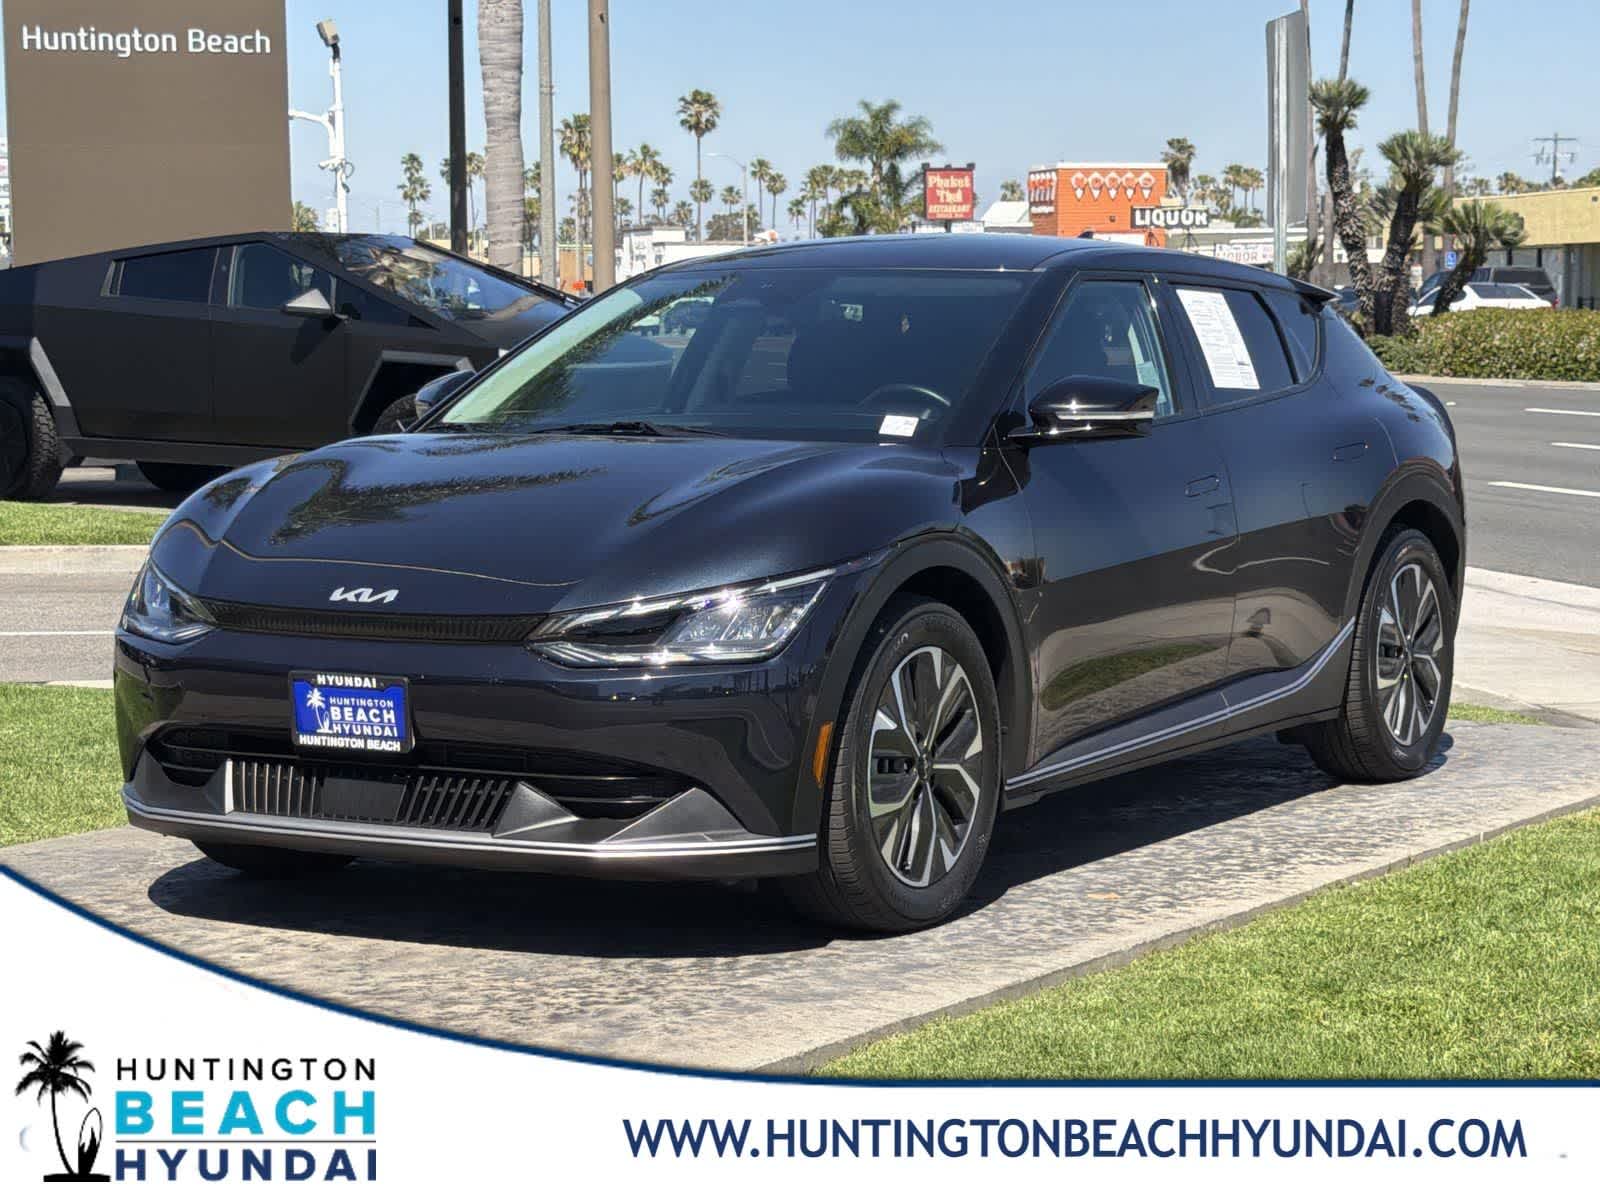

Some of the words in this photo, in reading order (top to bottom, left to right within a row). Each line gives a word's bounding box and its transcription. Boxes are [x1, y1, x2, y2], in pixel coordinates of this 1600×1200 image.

[21, 25, 177, 57] Huntington
[187, 29, 271, 54] Beach
[1135, 208, 1208, 227] LIQUOR
[316, 674, 377, 689] HYUNDAI
[329, 695, 394, 709] HUNTINGTON
[330, 706, 396, 723] BEACH
[332, 722, 398, 738] HYUNDAI
[299, 734, 366, 750] HUNTINGTON
[367, 739, 401, 752] BEACH
